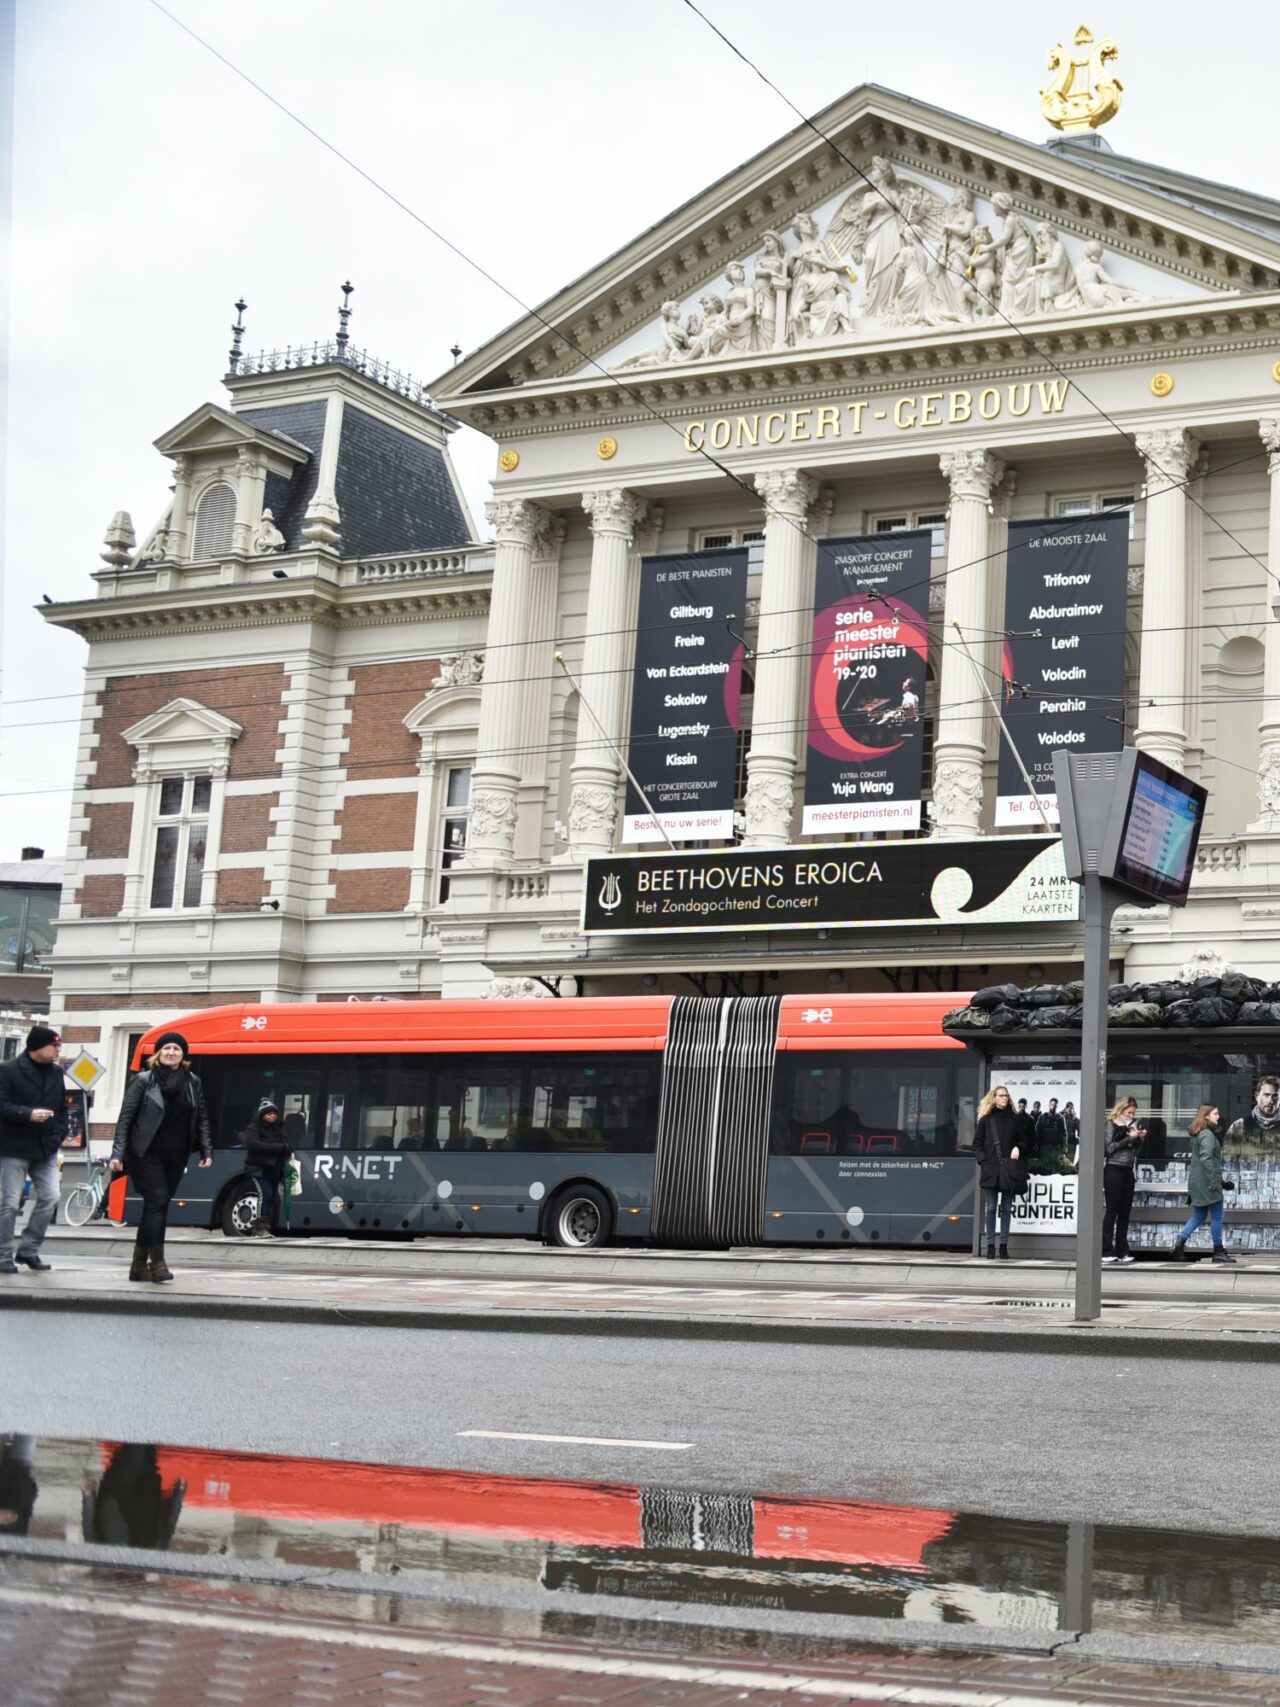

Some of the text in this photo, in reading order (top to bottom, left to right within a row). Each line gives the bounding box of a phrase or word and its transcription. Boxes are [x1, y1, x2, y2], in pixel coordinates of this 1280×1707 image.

[684, 379, 1072, 452] CONCERT-GEBOUW
[1029, 533, 1107, 548] DE MOOISTE ZAAL
[874, 550, 912, 561] CONCERT
[656, 567, 732, 582] DE BESTE PIANISTEN
[843, 562, 903, 575] MANAGEMENT
[1043, 573, 1091, 587] Trifonov
[670, 605, 713, 619] Giltburg
[835, 607, 873, 625] serie
[1029, 604, 1103, 620] Abduraimov
[674, 634, 705, 648] Freire
[834, 625, 899, 643] meester
[1051, 635, 1080, 650] Levit
[834, 643, 907, 666] pianisten
[647, 662, 729, 679] Von Eckardstein
[1041, 666, 1087, 682] Volodin
[664, 692, 708, 707] Sokolov
[1039, 698, 1086, 714] Perahia
[658, 722, 710, 739] Lugansky
[1037, 730, 1086, 745] Volodos
[666, 752, 698, 766] Kissin
[840, 770, 887, 780] EXTRA CONCERT
[643, 780, 718, 792] HET CONCERTGEBOUW
[831, 781, 894, 798] Yuja Wang
[659, 792, 699, 801] GROTE ZAAL
[812, 806, 913, 821] meesterpianisten.nl
[1008, 801, 1025, 812] Tel.
[664, 820, 676, 828] nu
[680, 819, 693, 828] uw
[696, 816, 722, 827] serie!
[637, 860, 883, 892] BEETHOVENS EROICA
[1030, 876, 1044, 887] 24
[1027, 889, 1073, 901] LAATSTE
[635, 894, 819, 915] Het Zondagochtend Concert
[1022, 903, 1073, 914] KAARTEN
